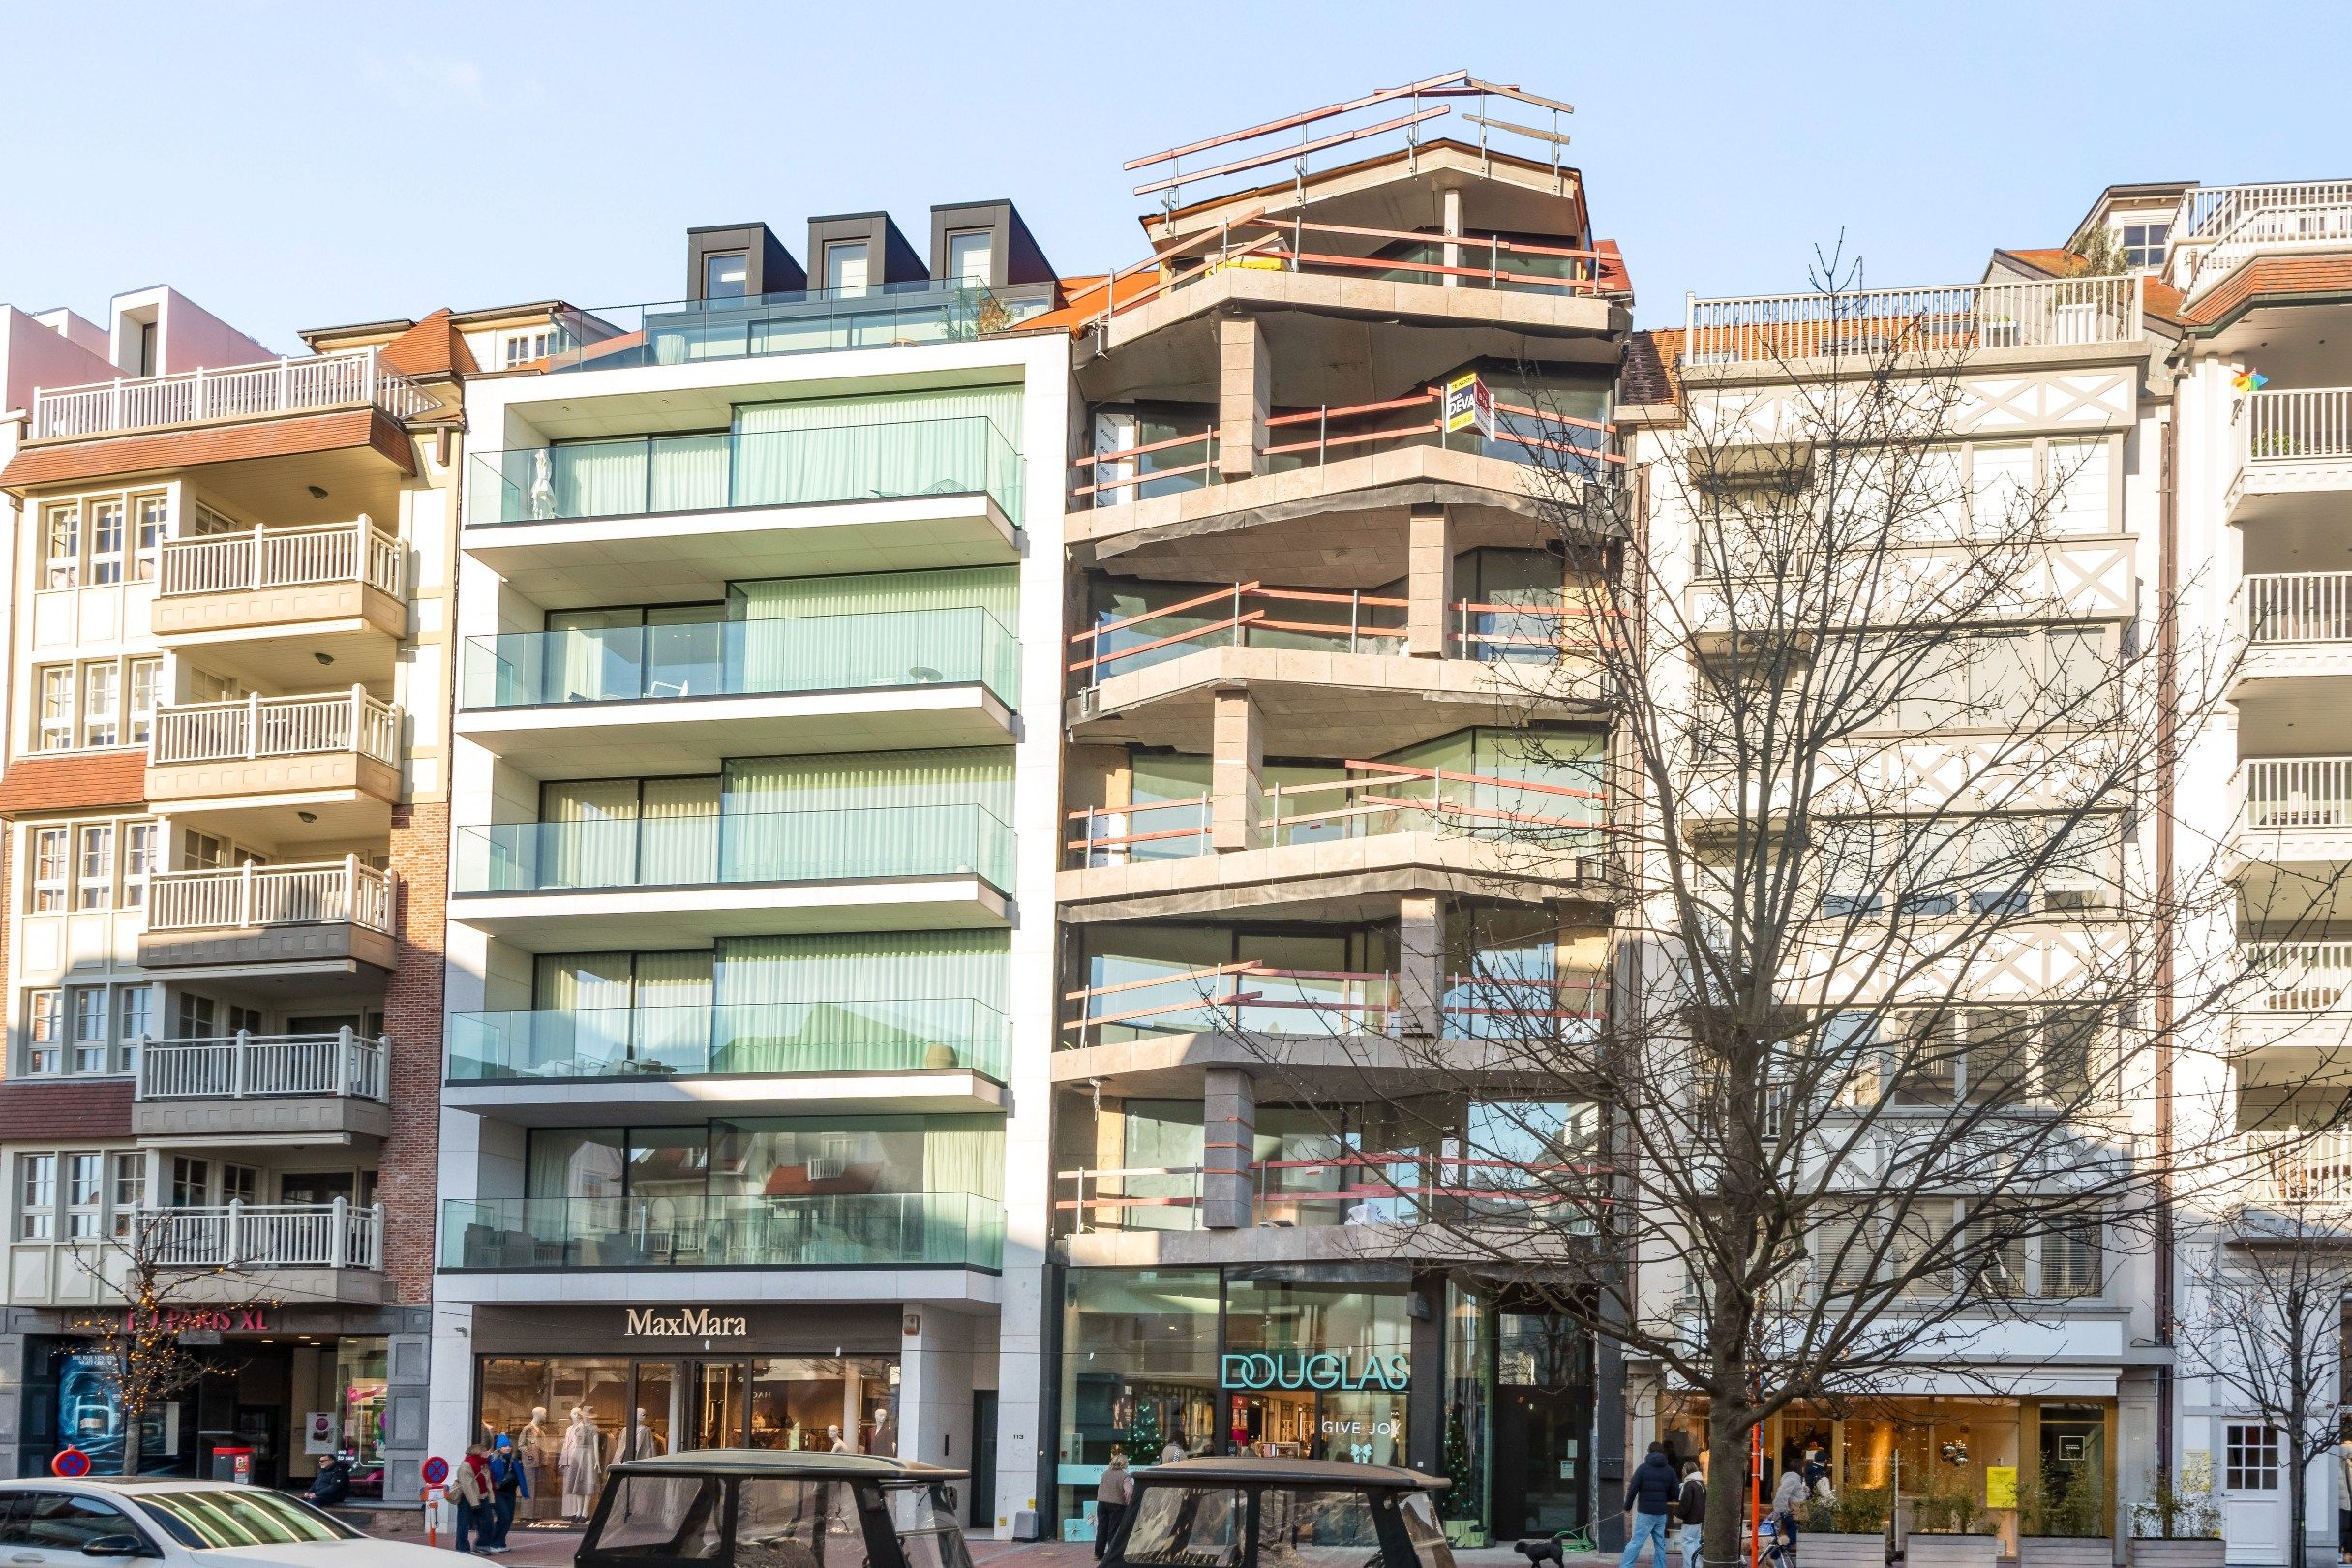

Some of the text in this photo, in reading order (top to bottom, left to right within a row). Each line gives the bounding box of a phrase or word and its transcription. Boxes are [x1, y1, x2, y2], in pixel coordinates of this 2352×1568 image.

[1449, 394, 1475, 416] DEVA
[240, 1308, 270, 1331] XL
[624, 1308, 747, 1336] MaxMara
[1221, 1353, 1408, 1390] DOUGLAS
[1322, 1421, 1402, 1435] GIVE JOY
